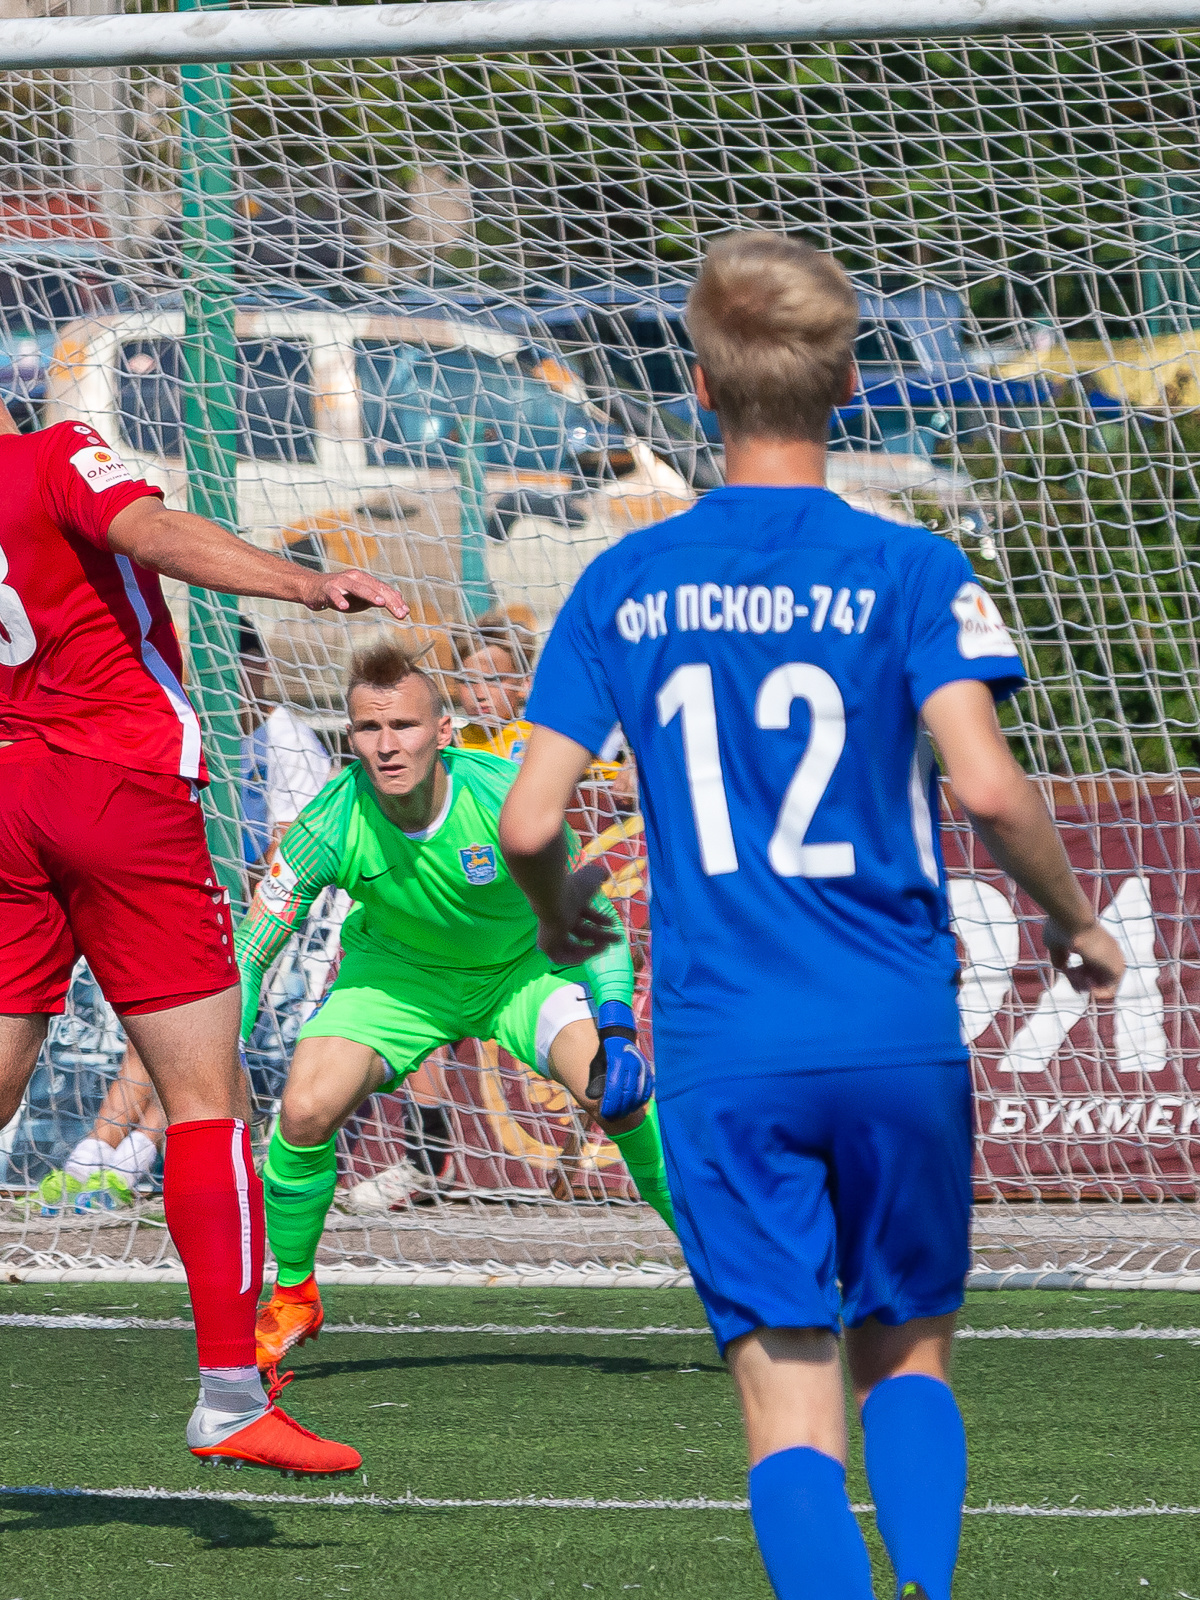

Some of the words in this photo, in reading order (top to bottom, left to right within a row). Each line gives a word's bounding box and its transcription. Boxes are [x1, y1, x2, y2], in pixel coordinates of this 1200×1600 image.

[615, 589, 668, 645] ФК
[675, 581, 877, 636] ПСКОВ-747
[655, 661, 857, 879] 12
